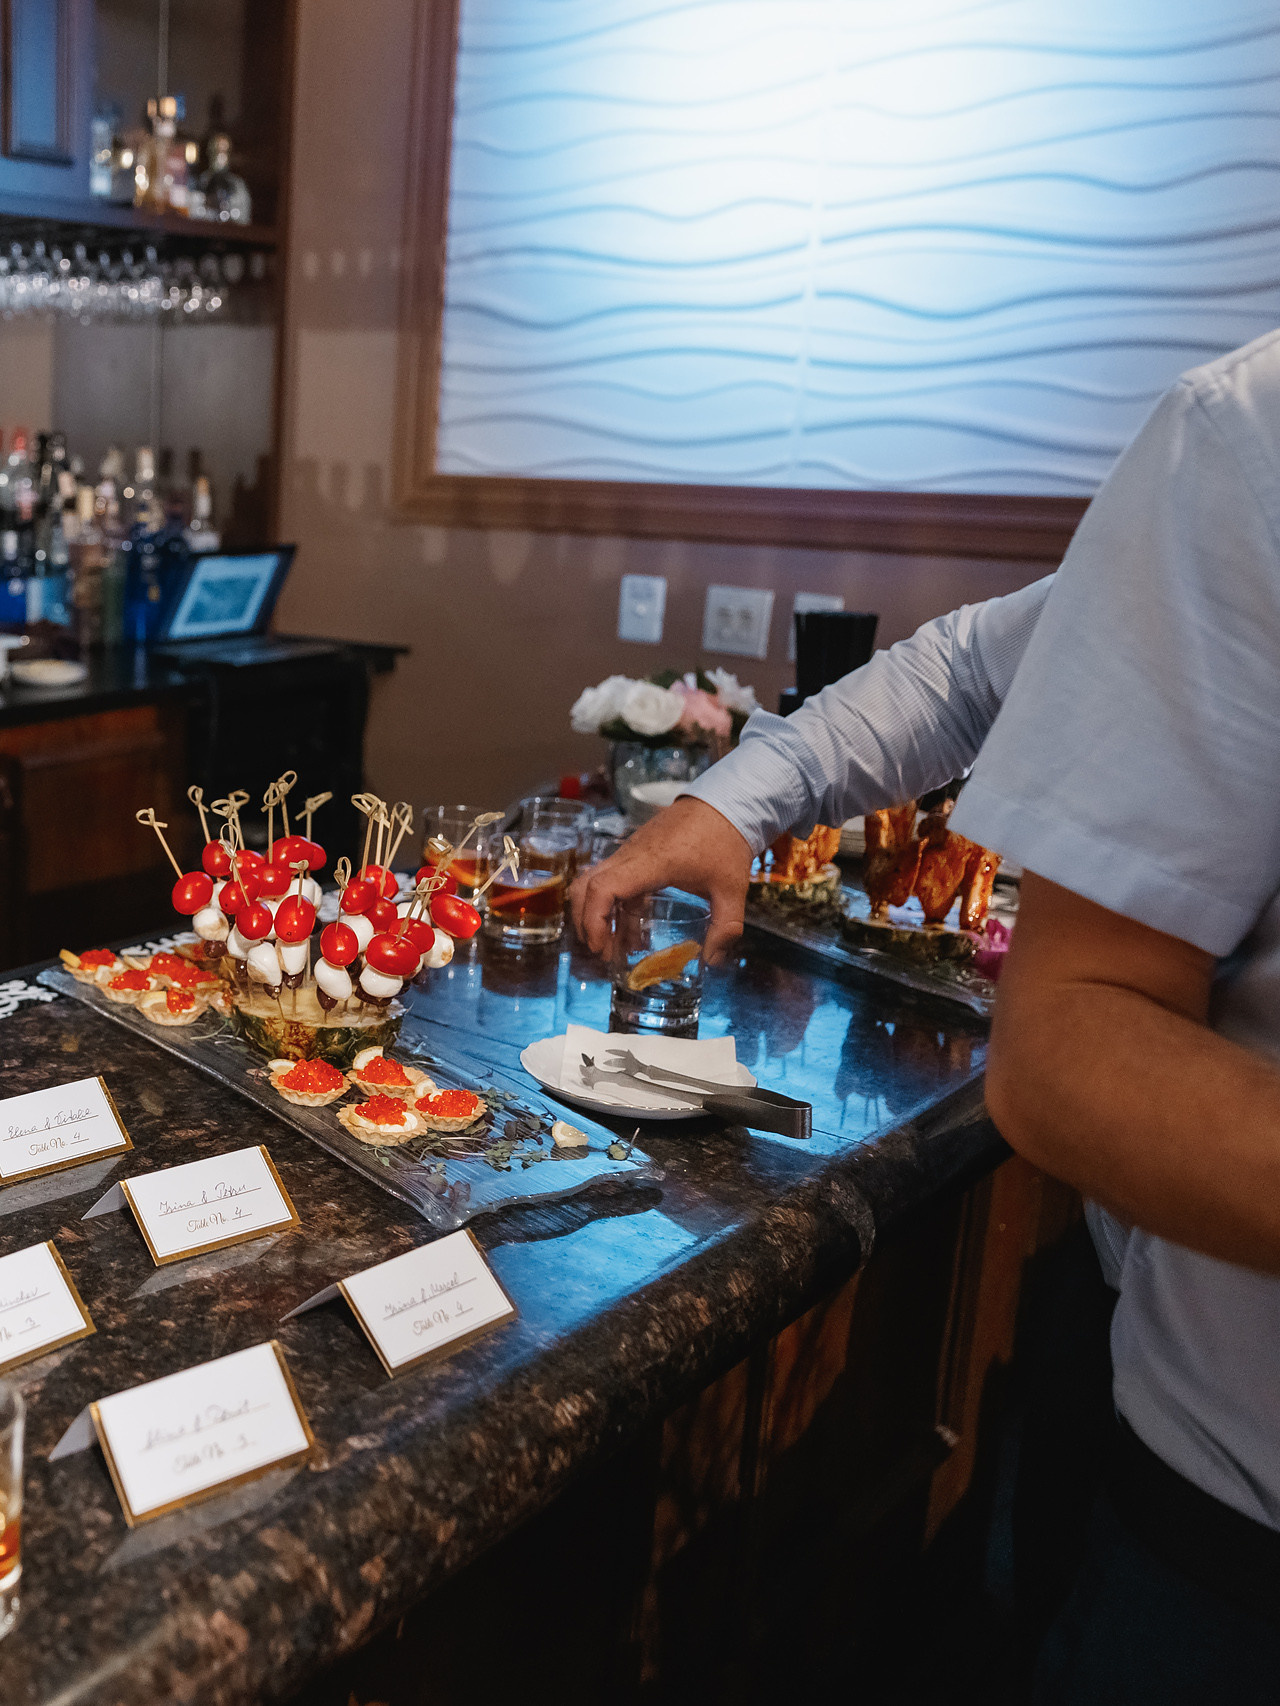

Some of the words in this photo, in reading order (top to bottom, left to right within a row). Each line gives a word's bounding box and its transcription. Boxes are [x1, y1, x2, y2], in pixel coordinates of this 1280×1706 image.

[8, 1125, 38, 1138] Elena
[45, 1116, 51, 1129] &
[29, 1143, 50, 1156] Table
[201, 1190, 208, 1204] &
[187, 1219, 209, 1232] Table
[413, 1320, 434, 1336] Table
